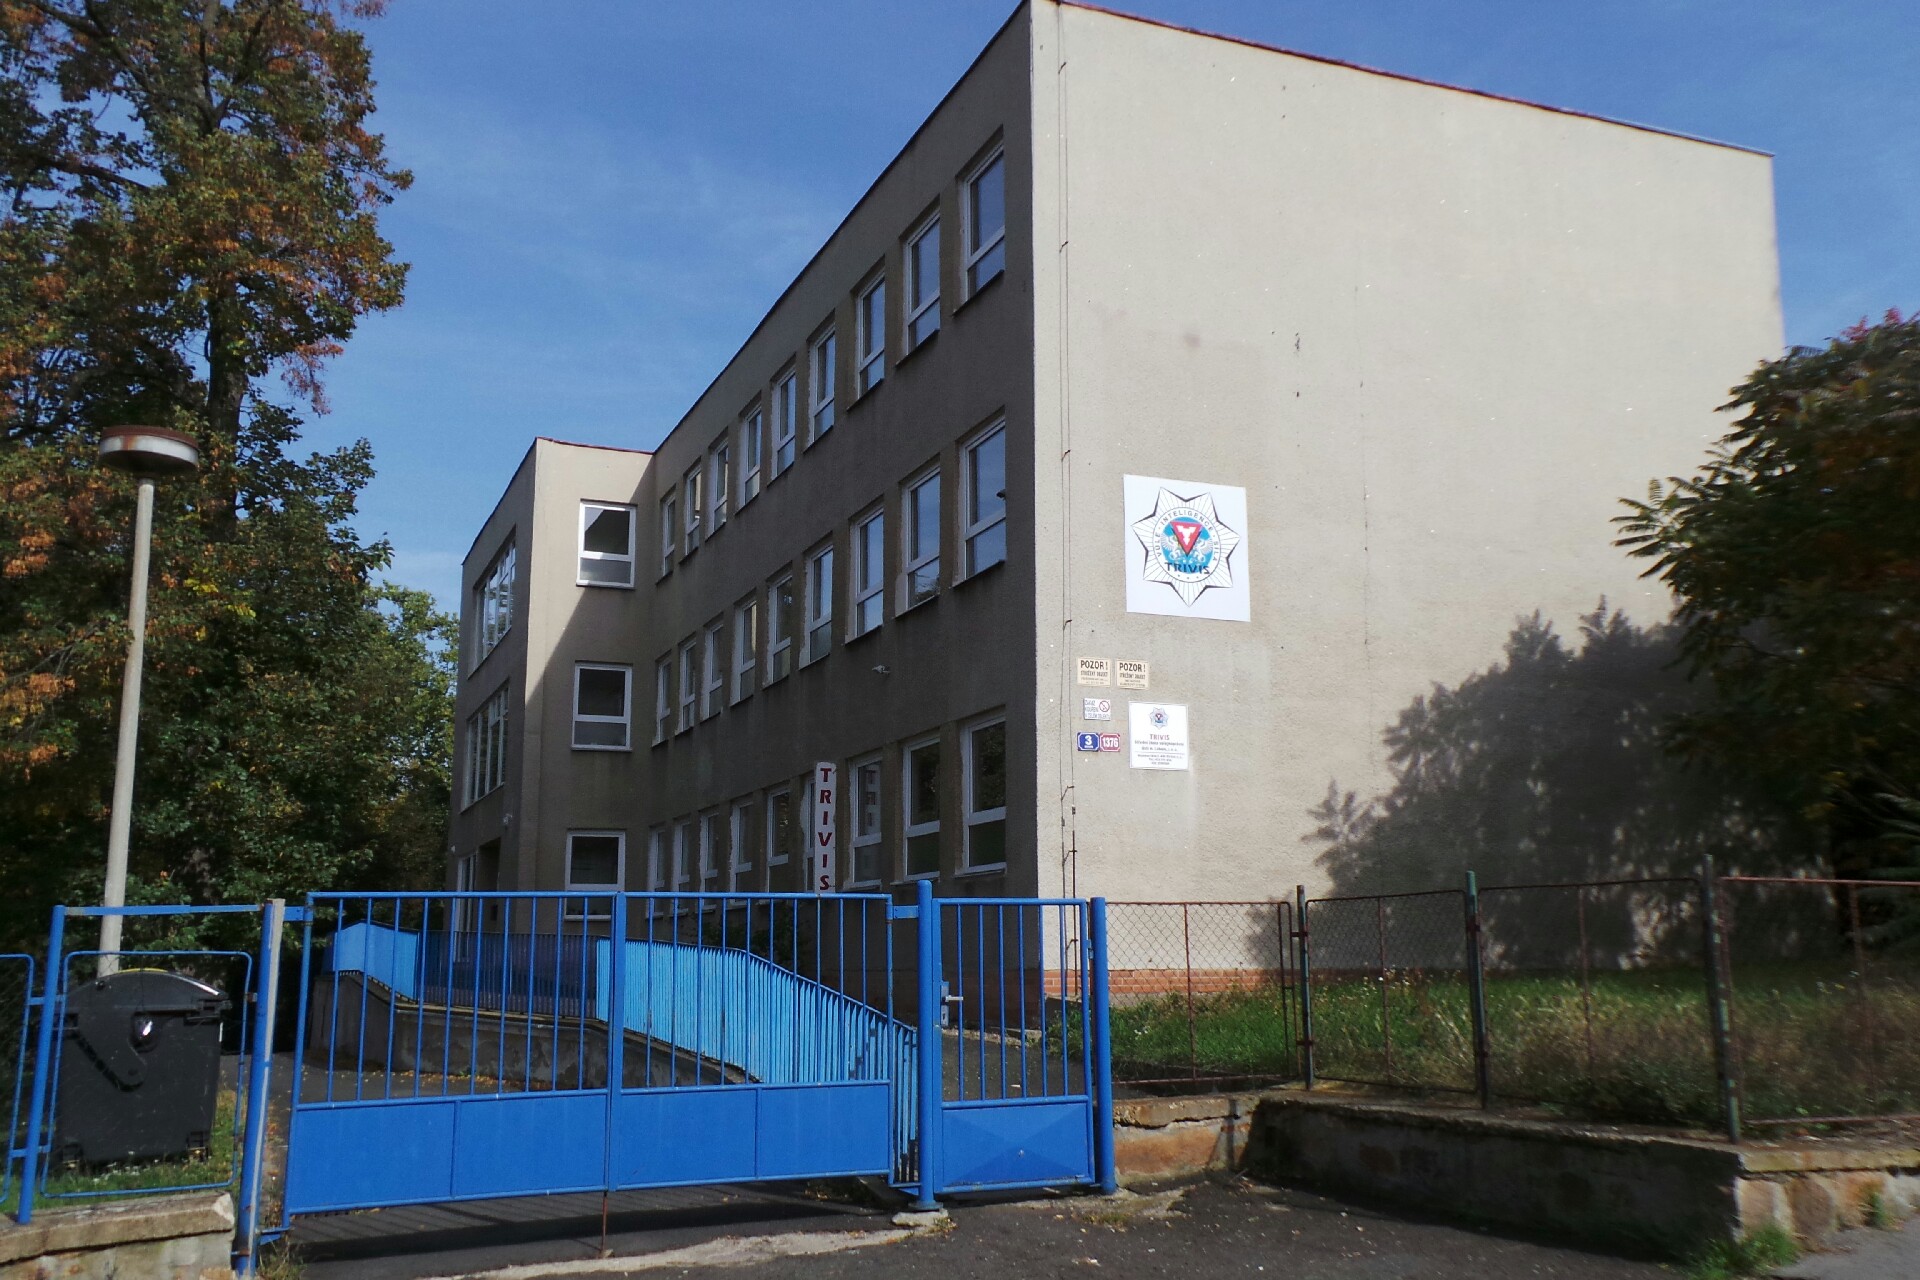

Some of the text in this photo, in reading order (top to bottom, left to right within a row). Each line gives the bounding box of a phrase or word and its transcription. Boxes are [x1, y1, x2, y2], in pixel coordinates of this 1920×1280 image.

[1162, 510, 1213, 531] INTELIGENCE
[1165, 562, 1210, 574] TRIVIS
[1084, 735, 1093, 746] 3
[1102, 737, 1119, 747] 1376
[818, 767, 833, 891] TRIVIS
